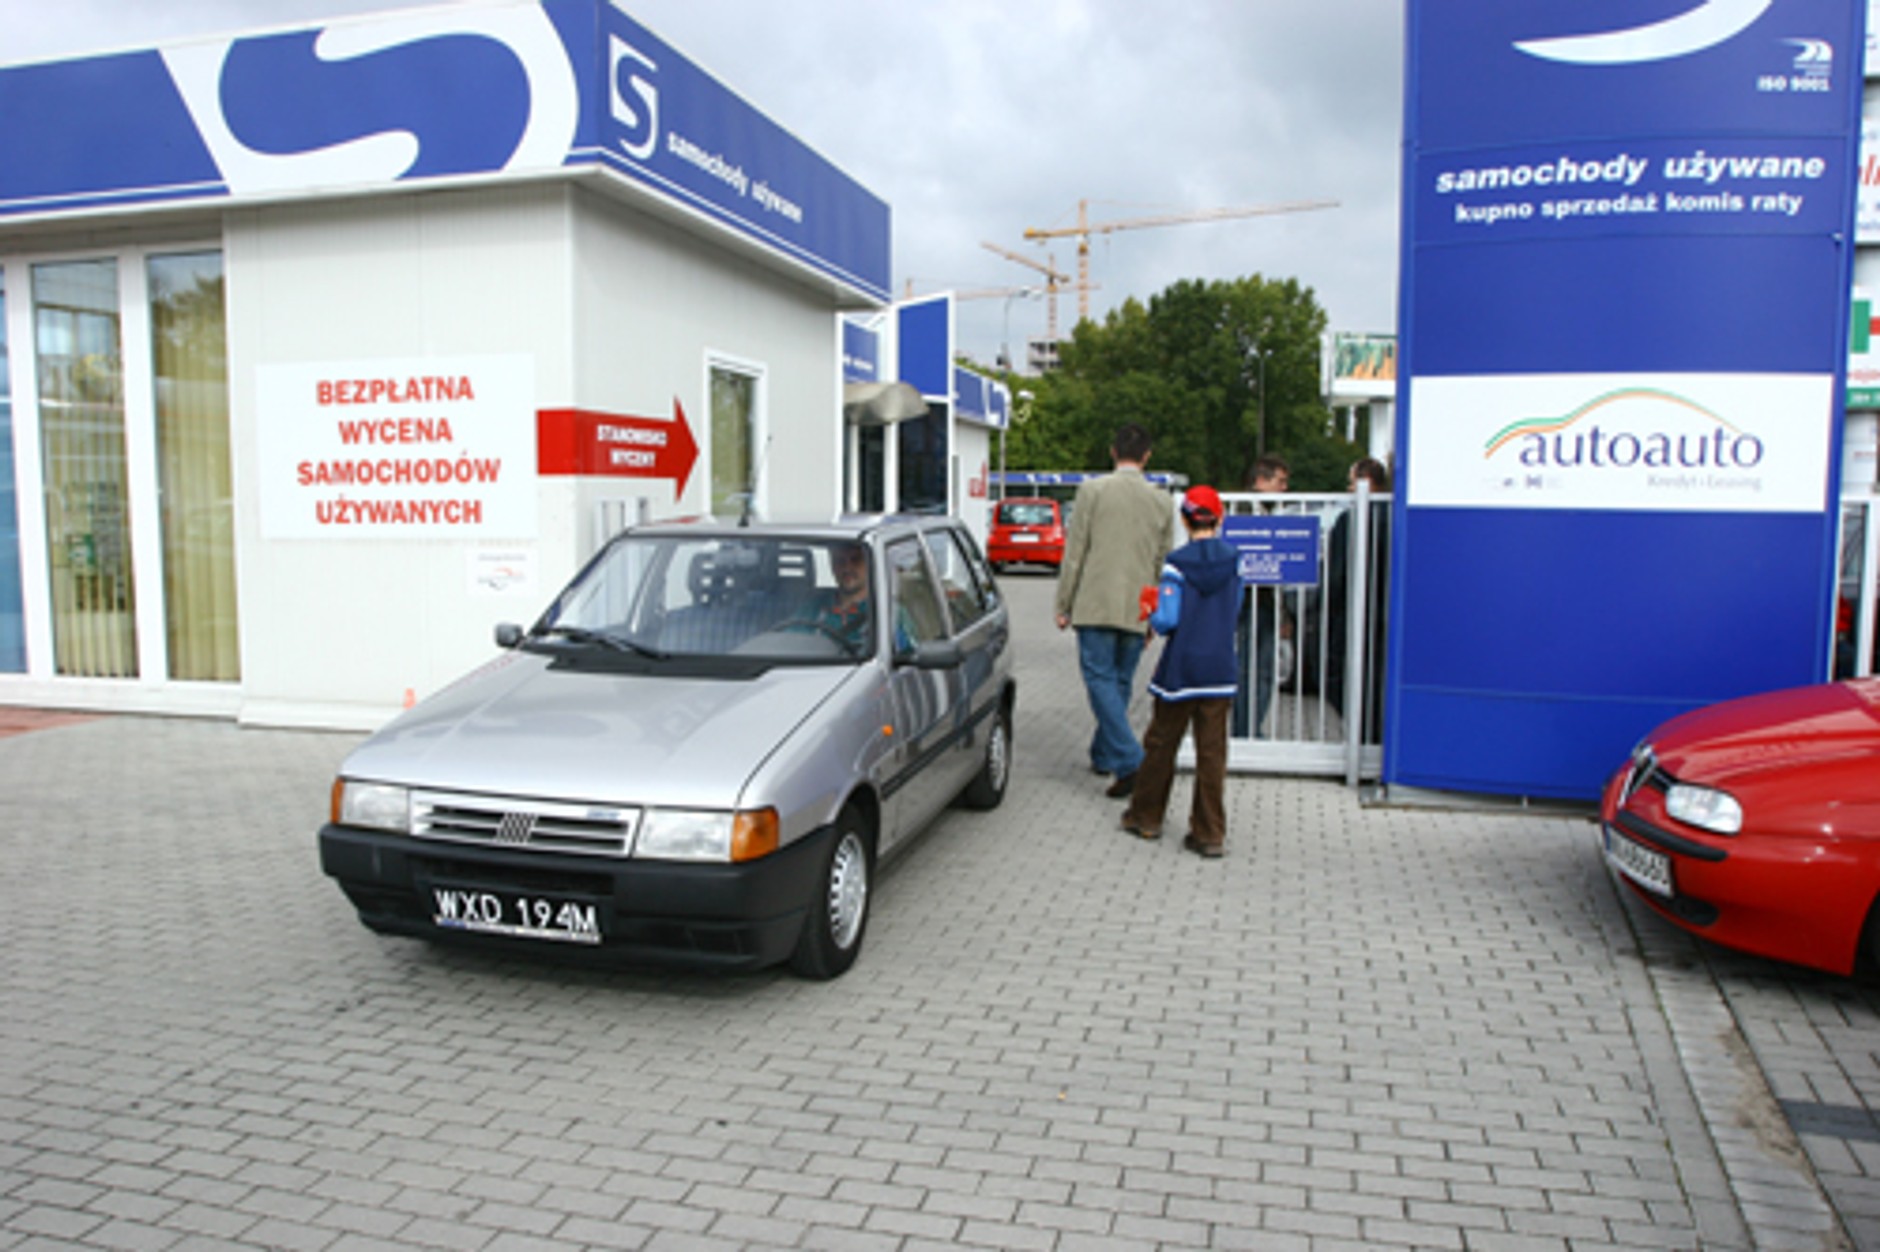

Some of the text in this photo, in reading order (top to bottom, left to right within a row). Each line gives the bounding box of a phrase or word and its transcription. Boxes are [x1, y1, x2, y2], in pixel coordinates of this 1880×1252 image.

[1436, 154, 1647, 193] samochody
[1664, 150, 1825, 181] używane
[1455, 190, 1803, 224] kupno sprzedaż komis raty
[316, 375, 475, 406] BEZPŁATNA
[338, 417, 454, 445] WYCENA
[1519, 426, 1765, 468] autoauto
[296, 449, 501, 486] SAMOCHODÓW
[315, 493, 483, 524] UŻYWANYCH
[433, 888, 599, 934] WXD 194M
